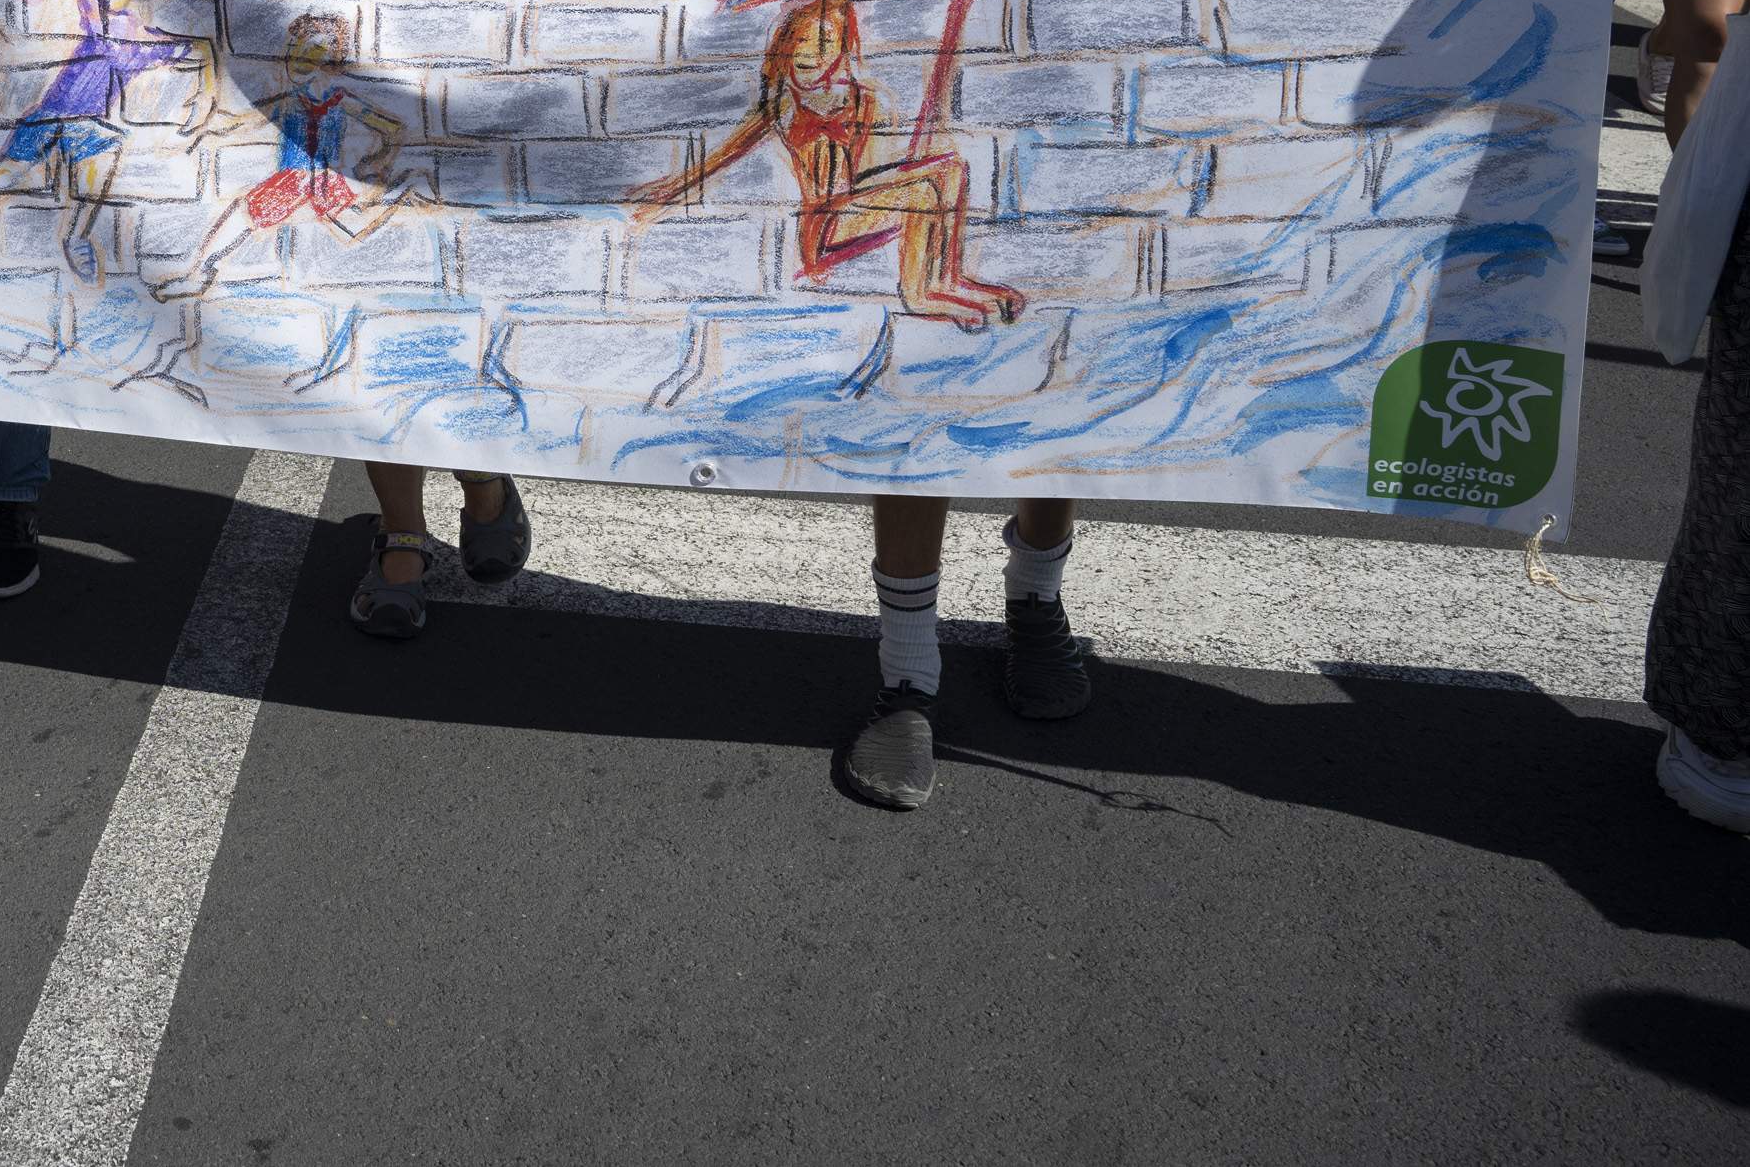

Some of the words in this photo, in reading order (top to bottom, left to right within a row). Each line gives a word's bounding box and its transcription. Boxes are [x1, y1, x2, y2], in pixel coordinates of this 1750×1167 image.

[1374, 457, 1516, 487] ecologistas
[1372, 479, 1403, 495] en
[1412, 482, 1499, 506] acción
